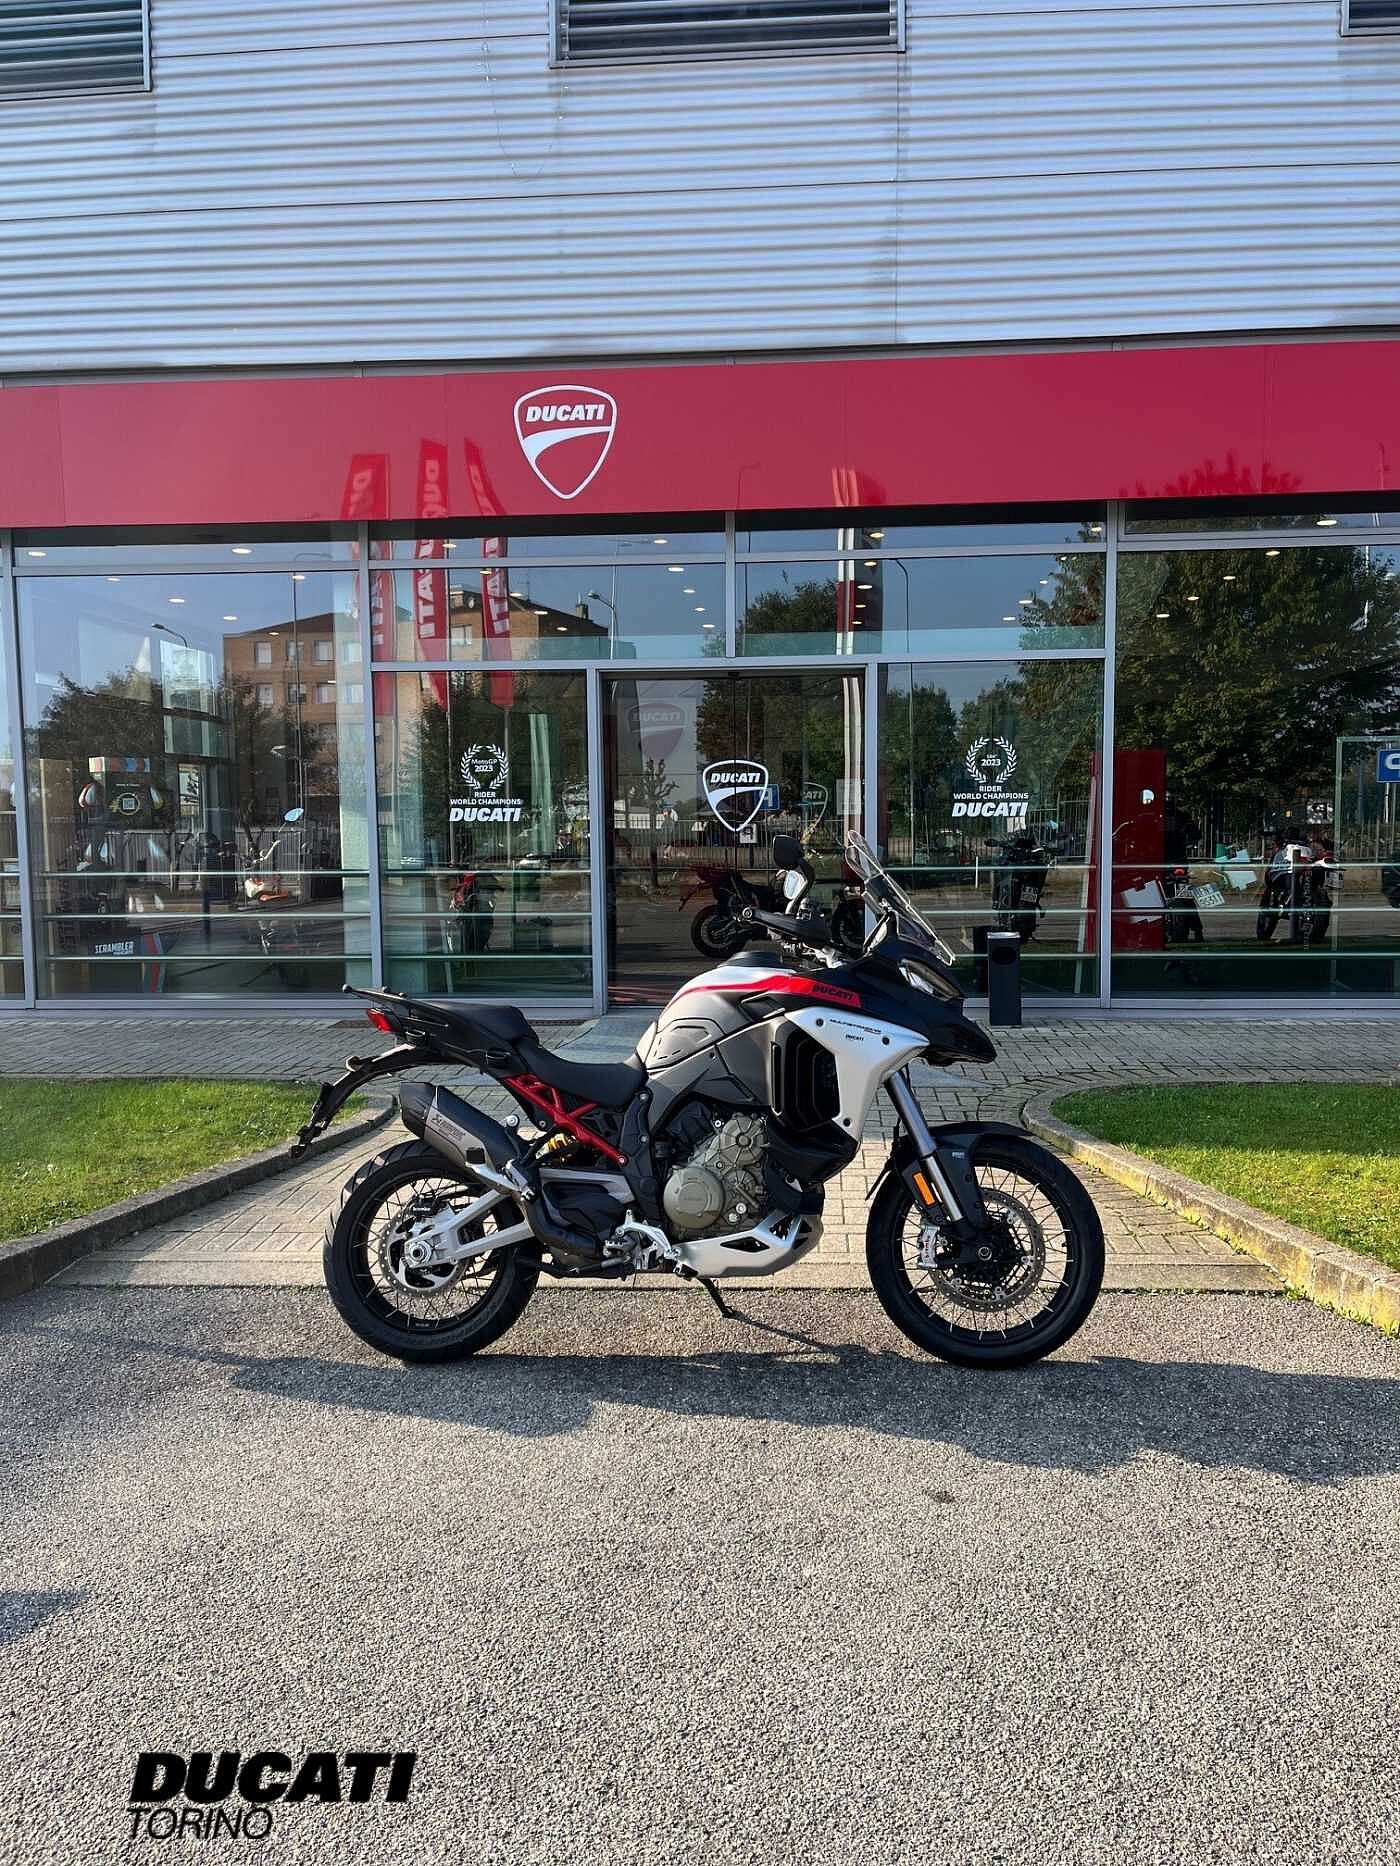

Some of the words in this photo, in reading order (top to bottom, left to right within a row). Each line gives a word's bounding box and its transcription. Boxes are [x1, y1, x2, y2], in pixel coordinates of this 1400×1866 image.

[526, 404, 605, 422] DUCATI
[981, 759, 1001, 767] 2023
[711, 772, 760, 783] DUCATI
[953, 792, 981, 800] WORLD
[983, 792, 1029, 800] CHAMPIONS
[449, 807, 521, 822] DUCATI
[952, 802, 1028, 817] DUCATI
[812, 983, 853, 1000] DUCATI
